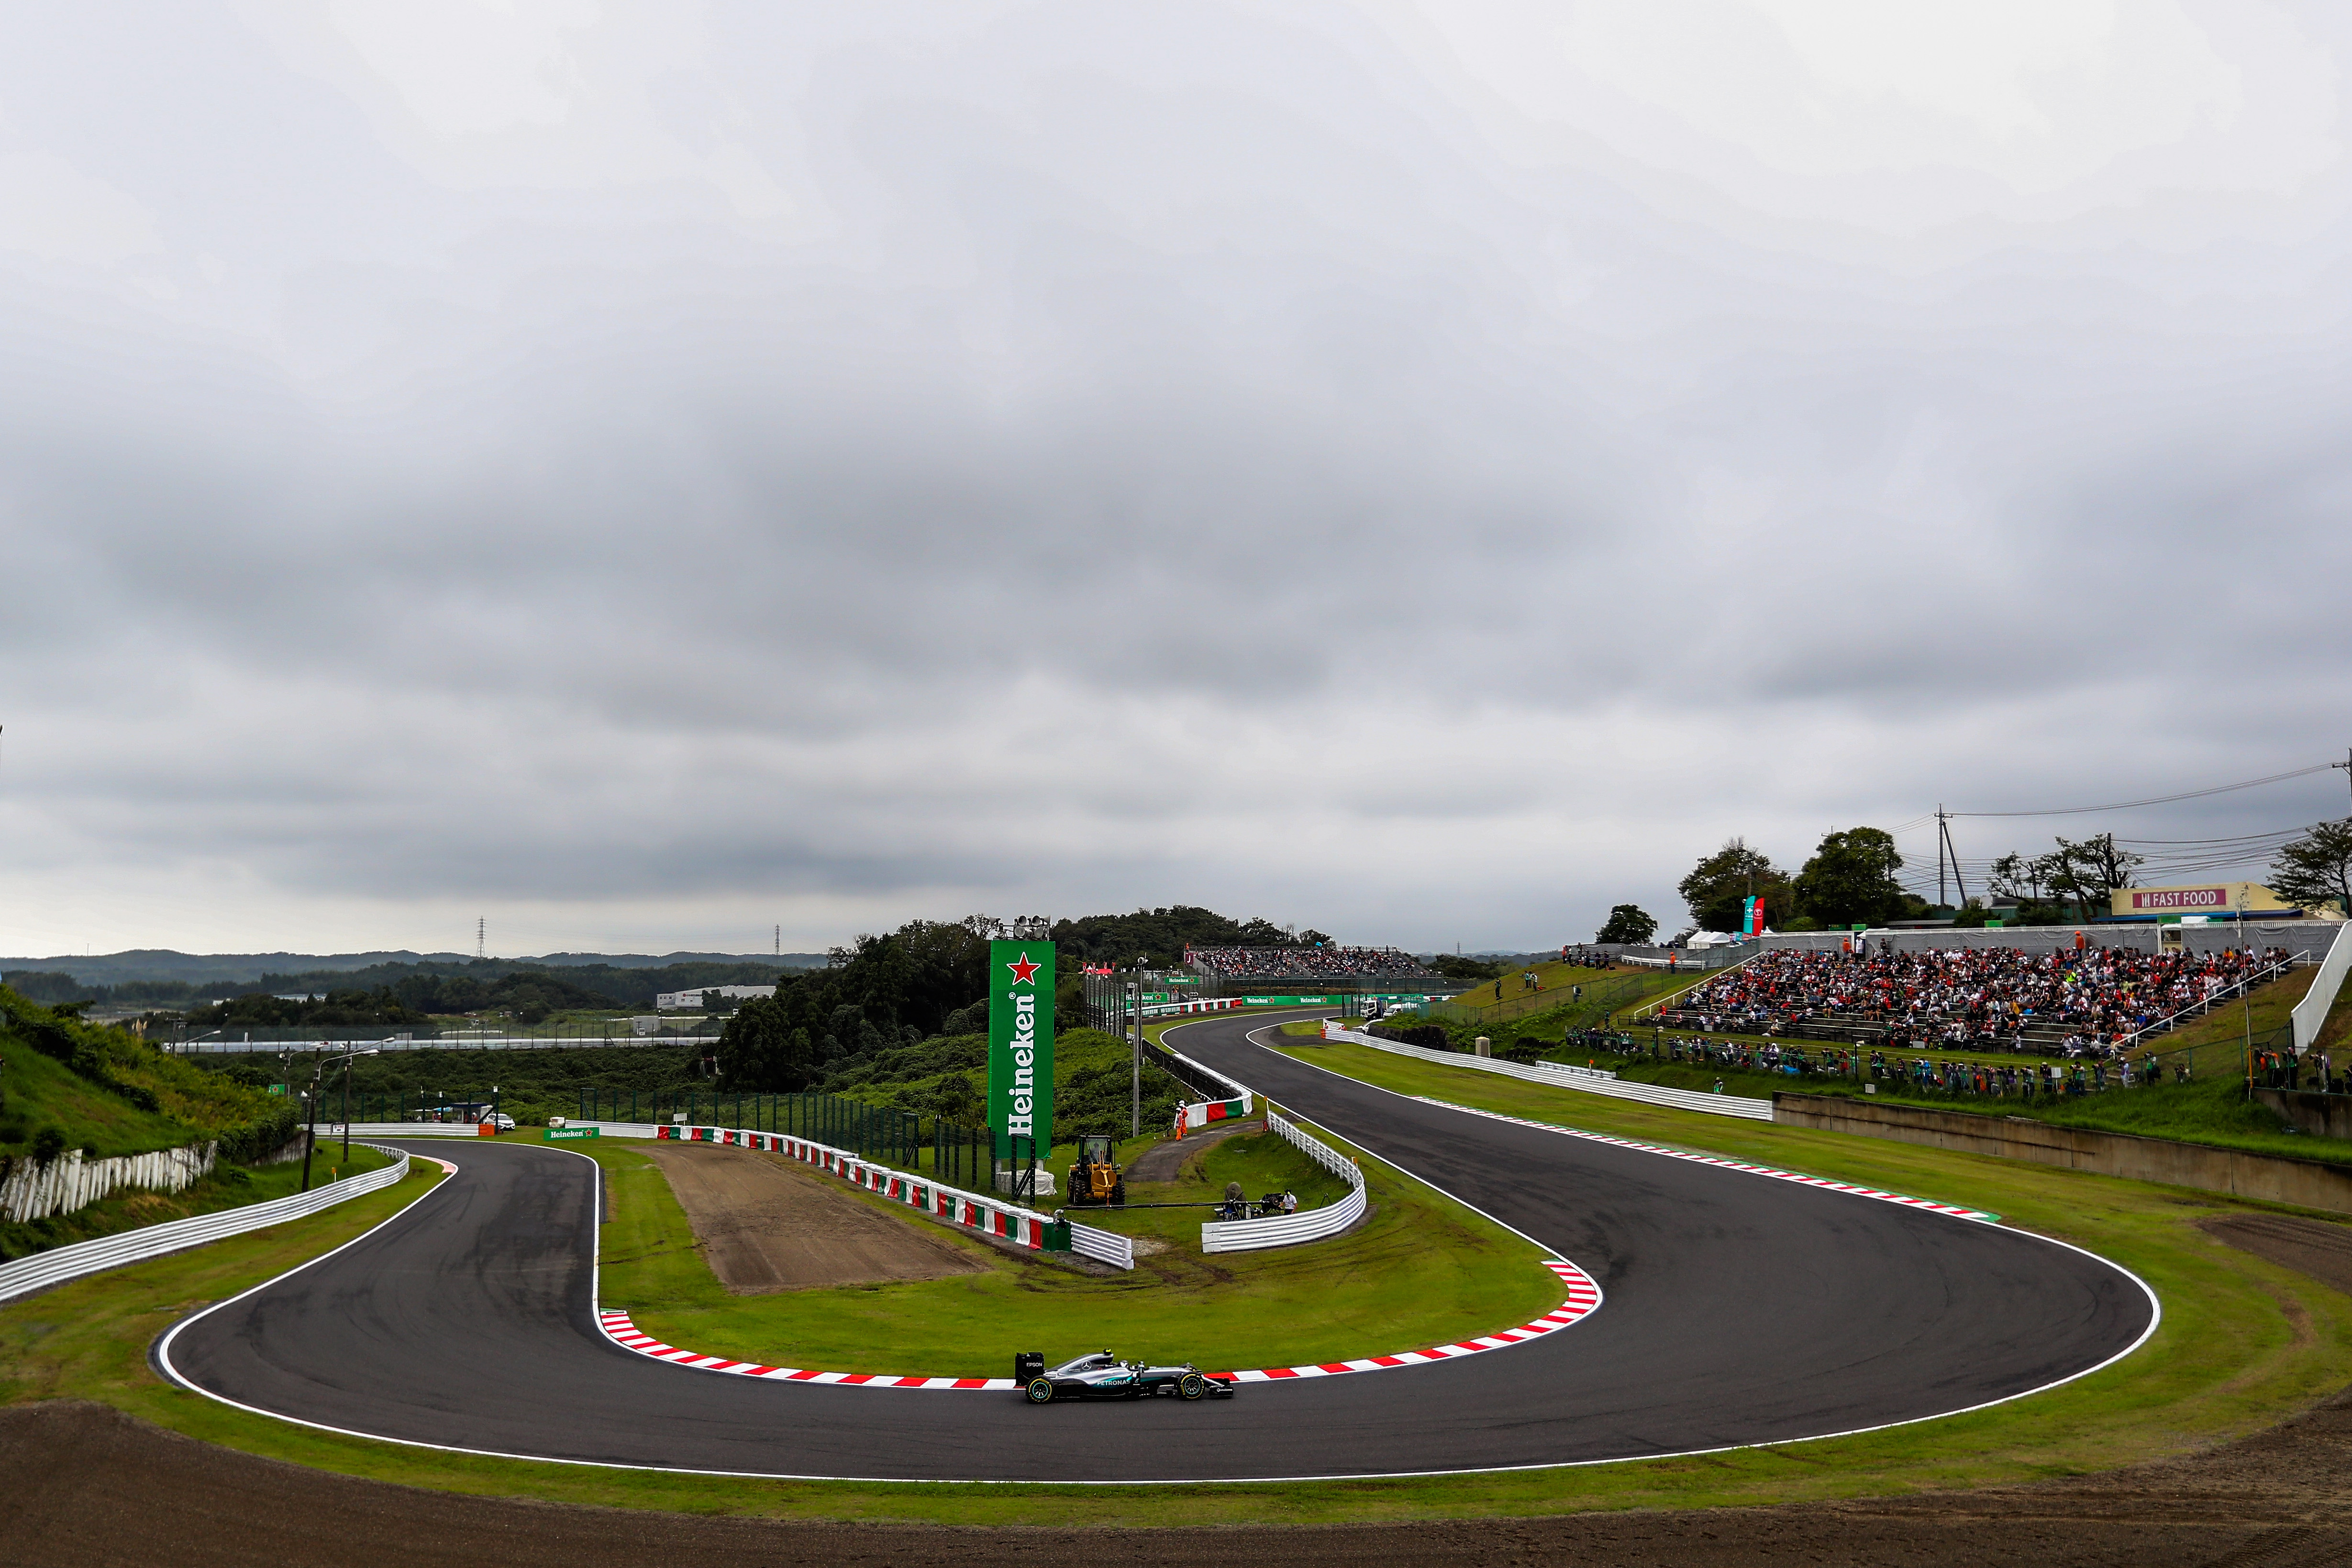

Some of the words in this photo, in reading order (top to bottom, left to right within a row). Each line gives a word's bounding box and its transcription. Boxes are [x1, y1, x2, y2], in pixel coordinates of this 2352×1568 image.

[2153, 892, 2180, 906] FAST
[2183, 890, 2217, 905] FOOD
[550, 1130, 584, 1138] Heineken
